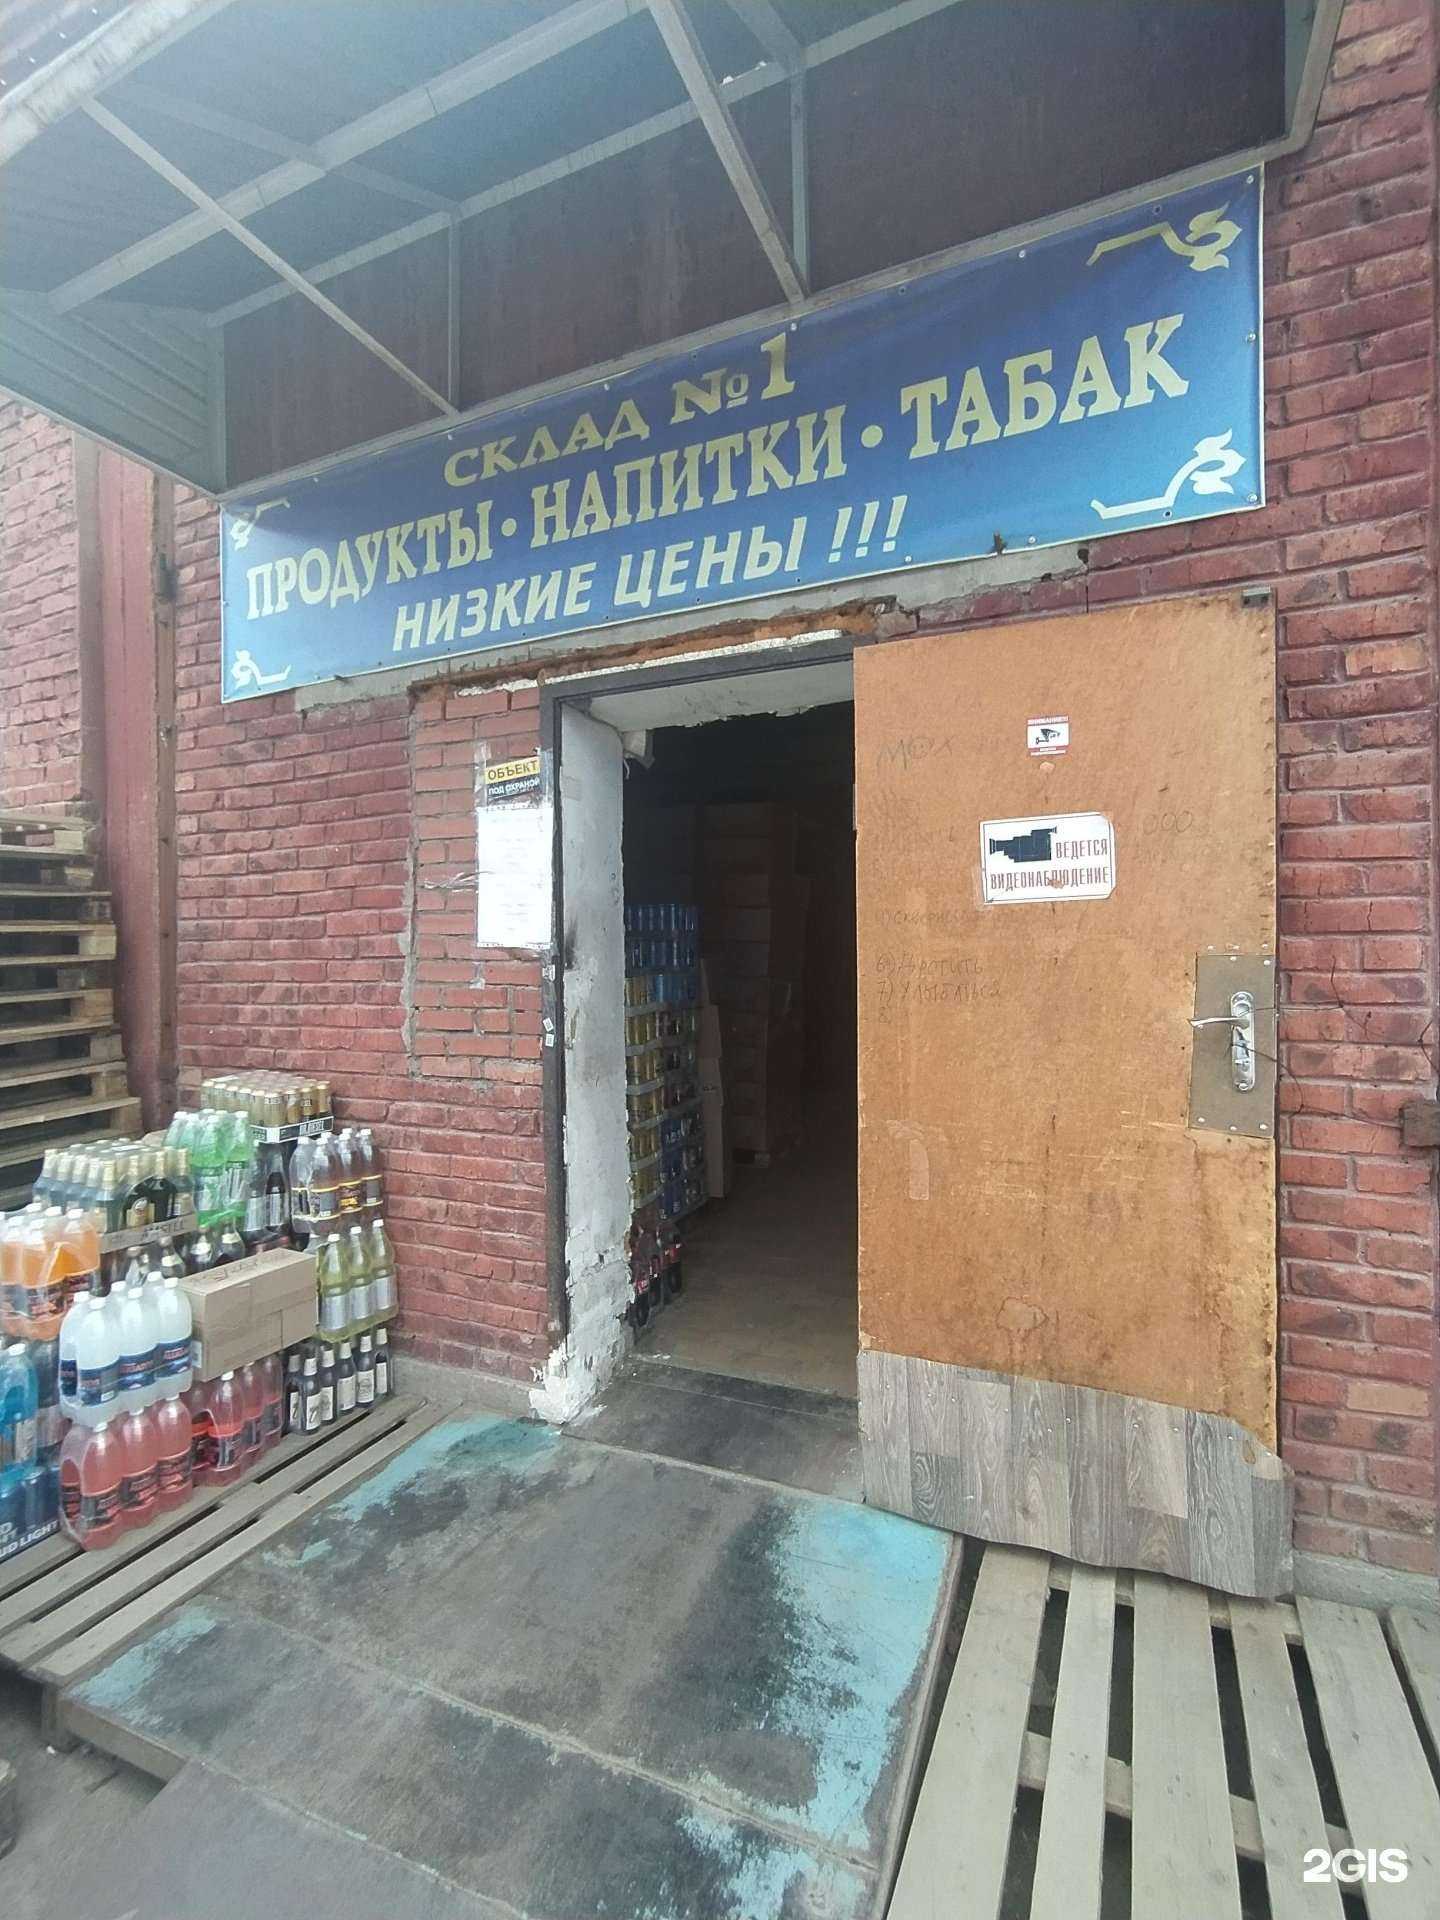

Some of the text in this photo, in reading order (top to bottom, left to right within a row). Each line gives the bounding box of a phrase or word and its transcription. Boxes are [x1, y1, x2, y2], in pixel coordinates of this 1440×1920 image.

[444, 399, 650, 487] СКЛАД
[246, 314, 1189, 621] ПРОДУКТЫ НАПИТКИ ТАБАК
[393, 562, 597, 651] НИЗКИЕ
[614, 518, 807, 609] ЦЕНЫ
[488, 760, 538, 780] ОБЪЕКТ
[488, 785, 504, 796] ПОД
[1055, 839, 1108, 859] ВЕДЕТСЯ
[991, 866, 1109, 892] ВИДЕОНАБЛЮДЕНИЕ
